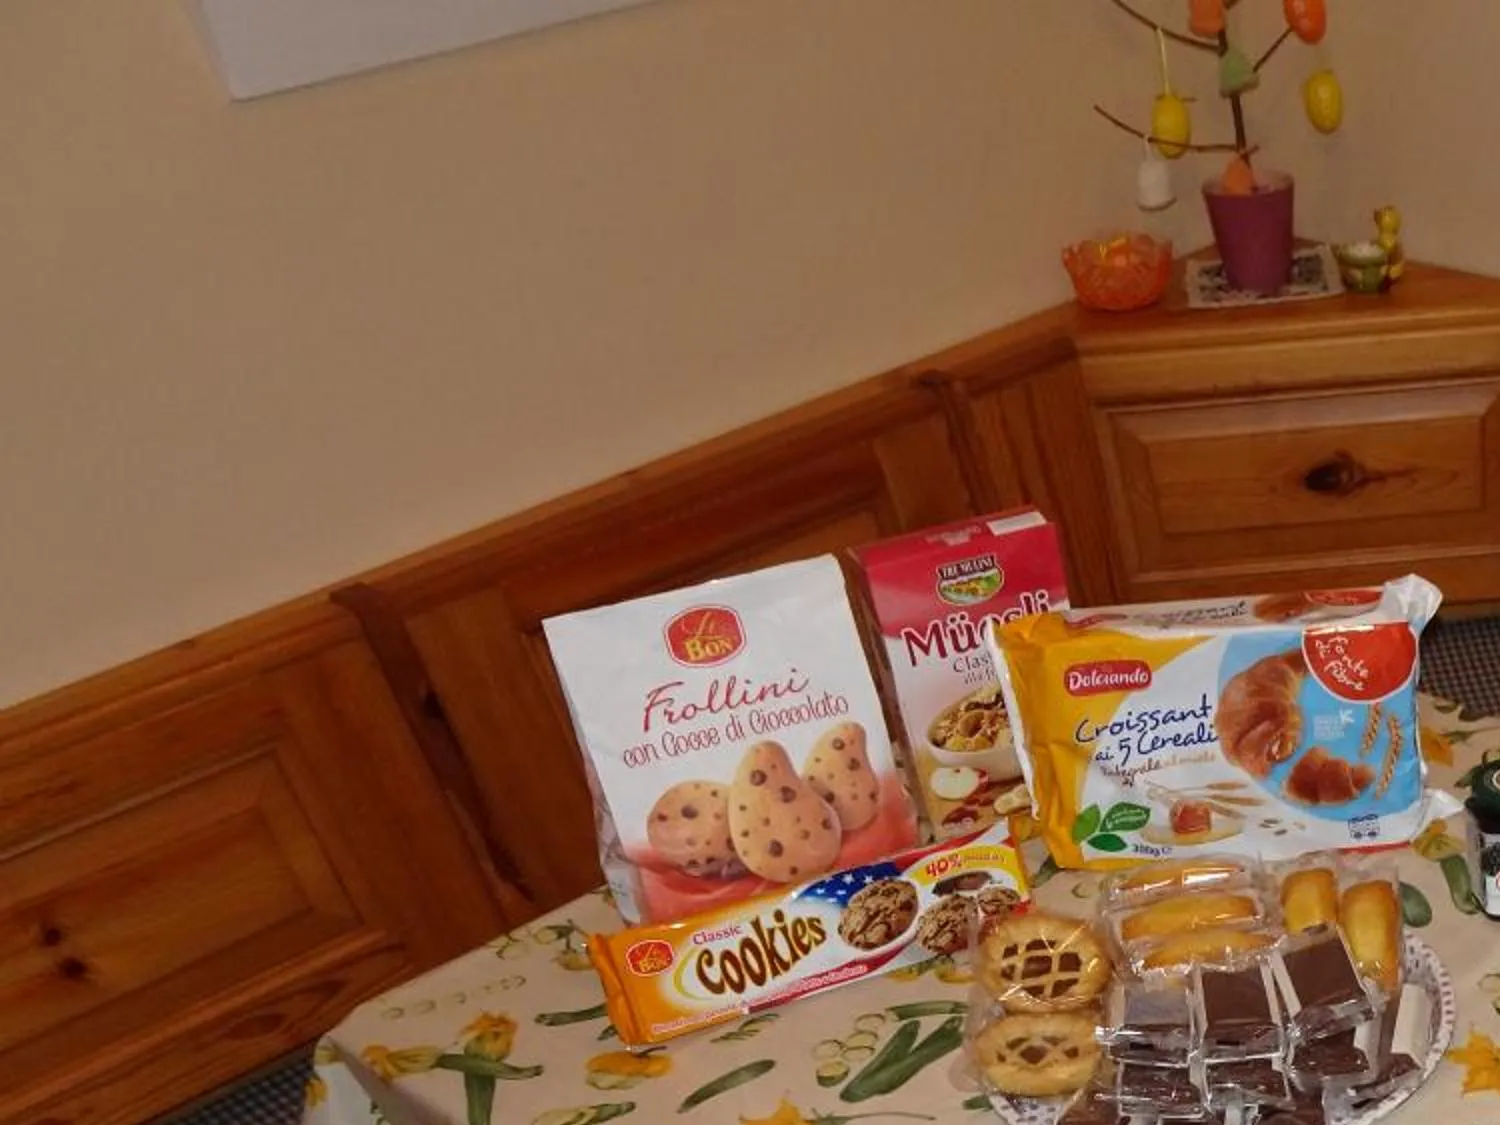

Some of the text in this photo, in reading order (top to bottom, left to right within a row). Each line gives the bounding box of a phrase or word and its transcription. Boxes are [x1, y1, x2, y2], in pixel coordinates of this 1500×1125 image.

[642, 668, 810, 734] Frollini
[1069, 667, 1149, 690] Dolciando
[622, 740, 661, 769] con
[724, 714, 747, 743] di
[749, 691, 850, 735] Cioccolato
[1075, 692, 1213, 743] Croissant
[1119, 736, 1132, 767] 5
[1137, 721, 1219, 755] Cereali
[692, 924, 742, 946] Classic
